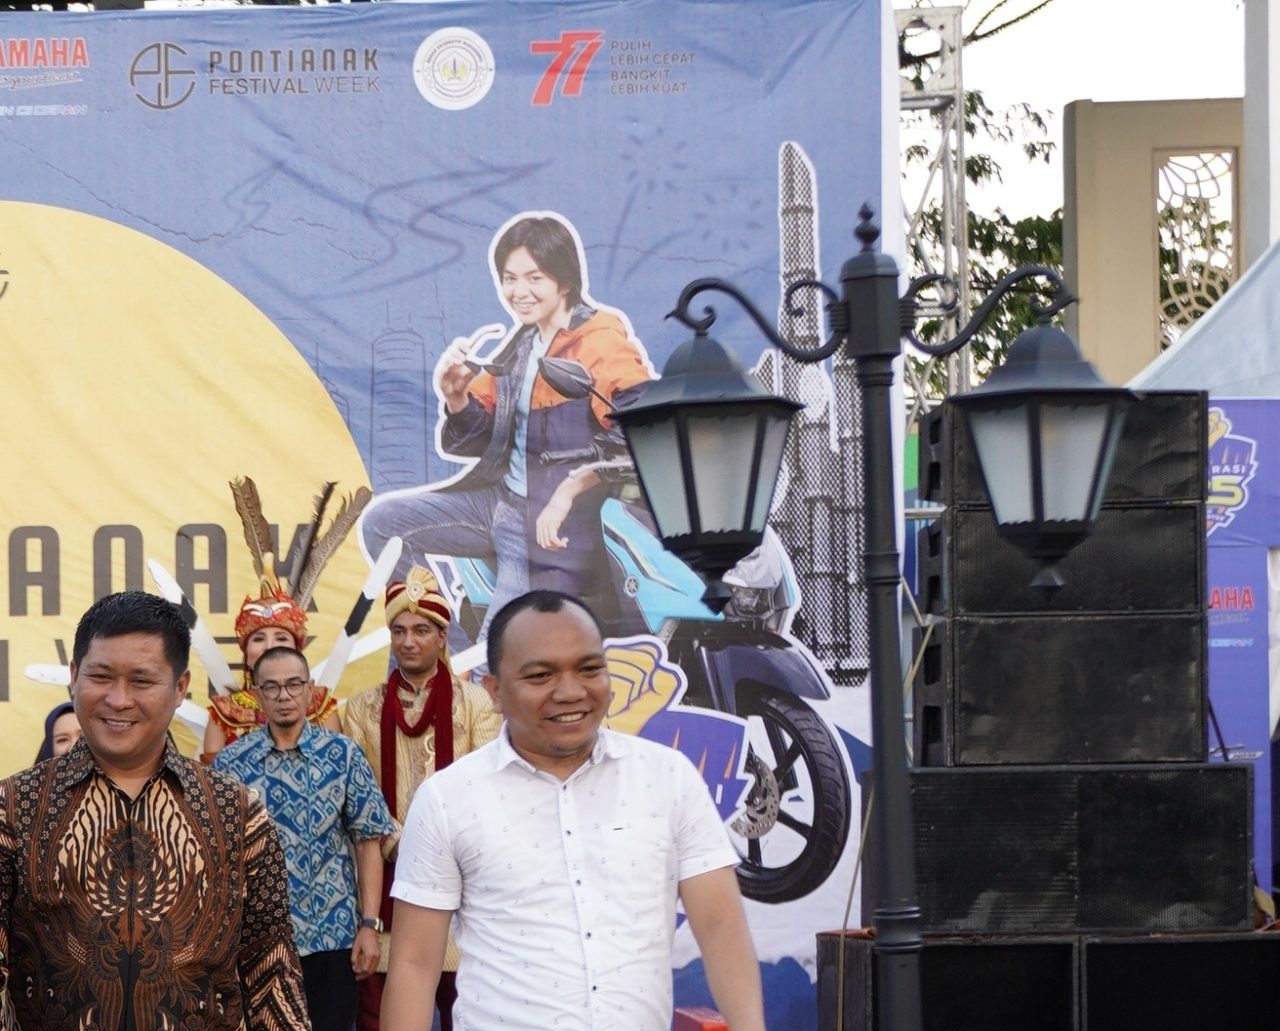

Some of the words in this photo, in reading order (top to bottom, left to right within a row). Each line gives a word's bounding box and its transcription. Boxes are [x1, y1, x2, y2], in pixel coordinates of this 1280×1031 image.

[611, 40, 651, 51] PULIH
[209, 48, 380, 73] PONTIANAK
[611, 54, 649, 65] LEBIH
[652, 53, 696, 65] CEPAT
[530, 29, 606, 107] 77
[611, 69, 670, 81] BANGKIT
[210, 78, 309, 96] FESTIVAL
[314, 76, 381, 93] WEEK
[611, 83, 649, 95] LEBIH
[652, 82, 688, 93] KUAT
